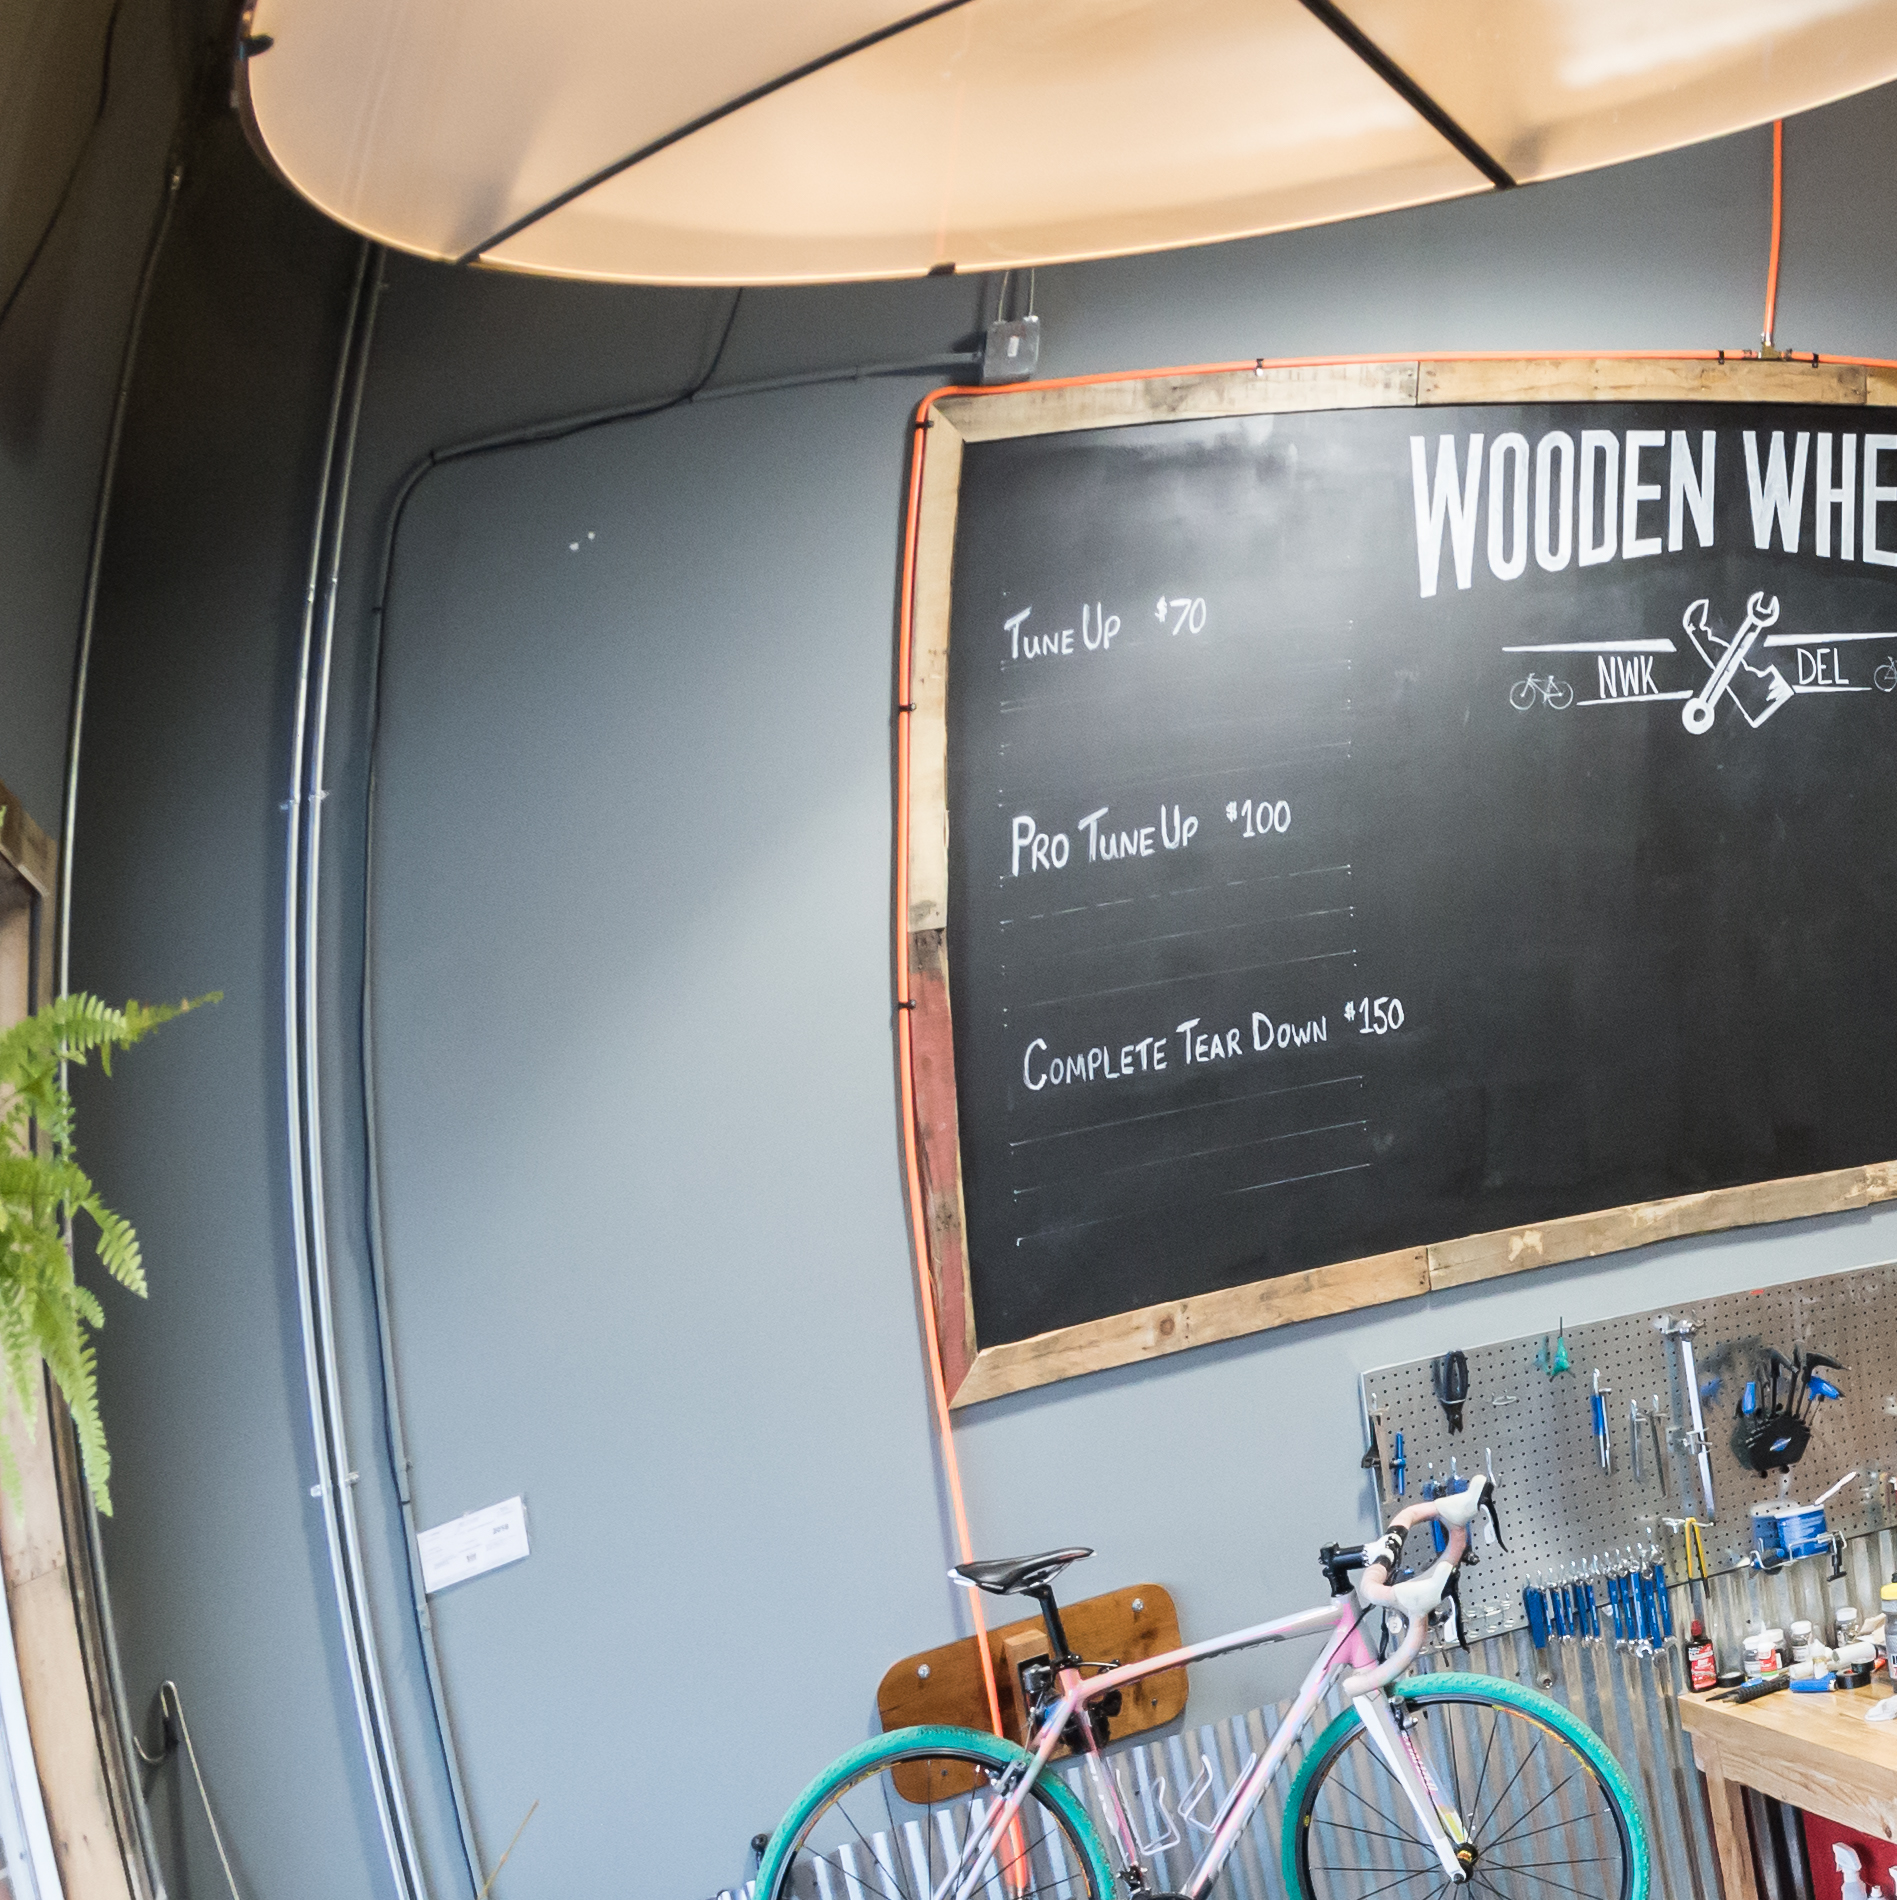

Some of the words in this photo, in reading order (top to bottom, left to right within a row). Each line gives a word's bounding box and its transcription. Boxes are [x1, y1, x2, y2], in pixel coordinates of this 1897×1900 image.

[1411, 430, 1715, 597] WOODEN
[1003, 606, 1074, 660] TUNE
[1082, 603, 1122, 650] UP
[1155, 597, 1207, 635] $70
[1599, 655, 1659, 699] NWK
[1797, 648, 1850, 685] DEL
[1011, 814, 1070, 877] PRO
[1077, 806, 1156, 863] TUNE
[1160, 804, 1200, 850] UP
[1226, 800, 1292, 838] $100
[1022, 1036, 1168, 1091] COMPLETE
[1176, 1017, 1243, 1065] TEAR
[1251, 1011, 1328, 1052] DOWN
[1344, 996, 1405, 1036] $150
